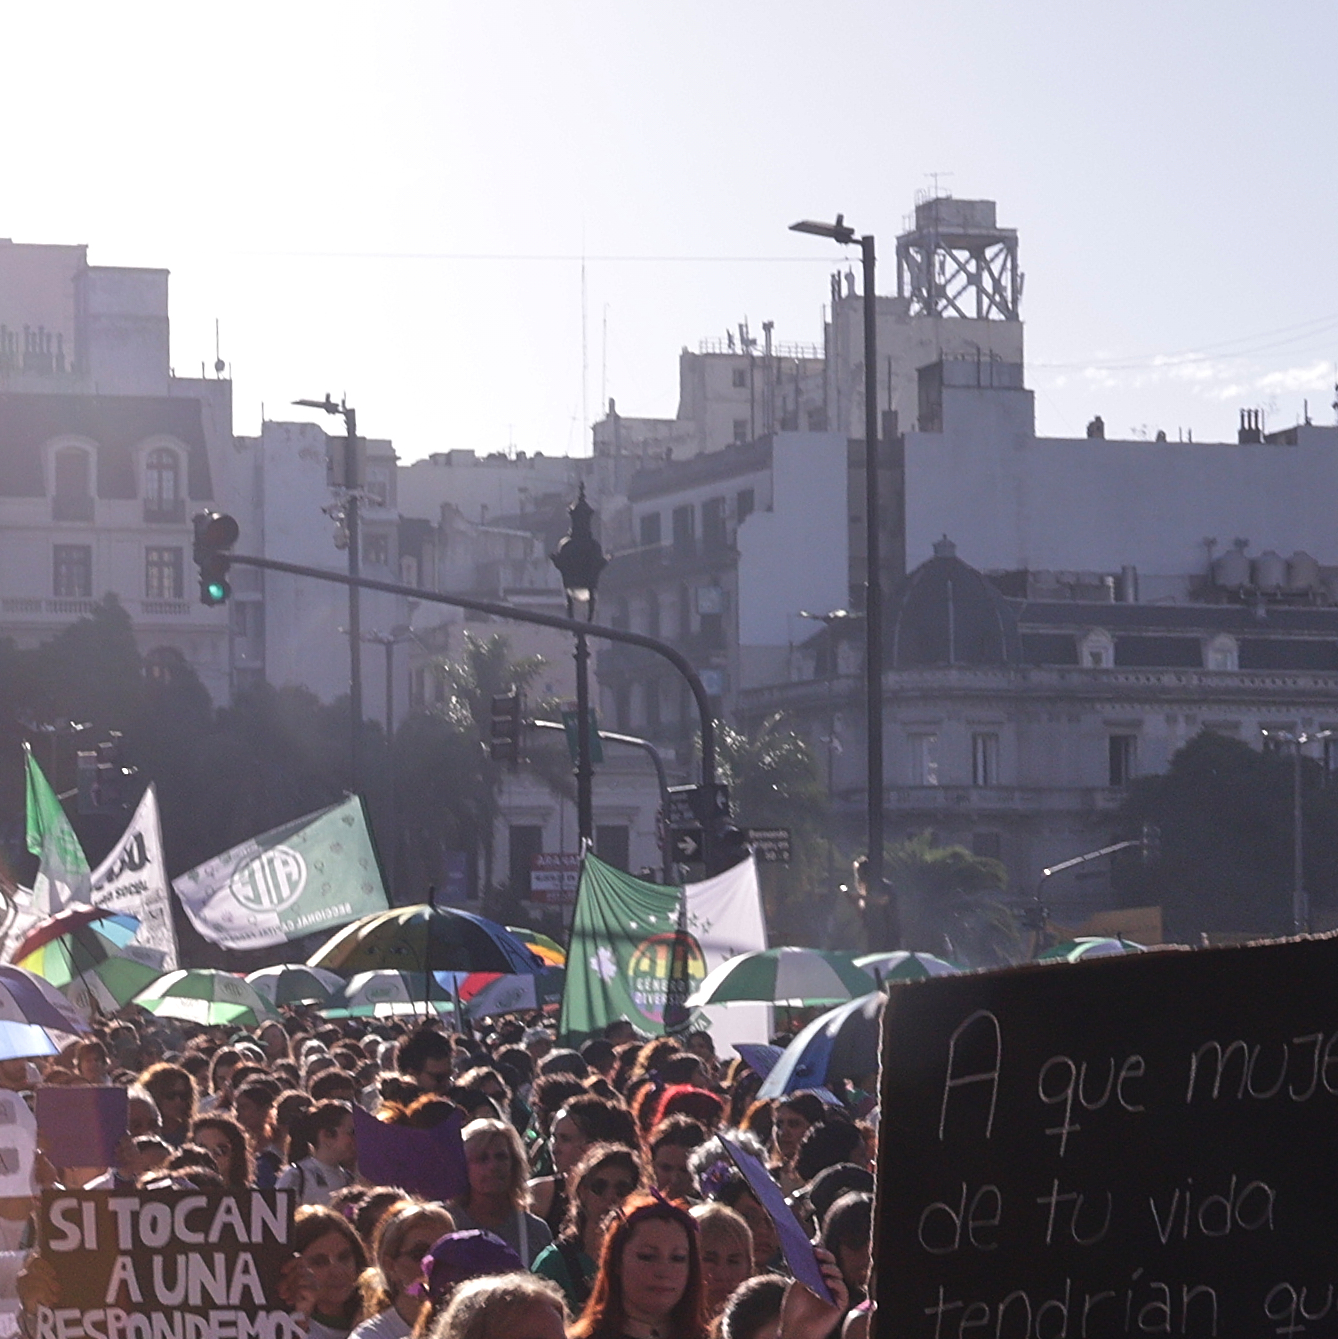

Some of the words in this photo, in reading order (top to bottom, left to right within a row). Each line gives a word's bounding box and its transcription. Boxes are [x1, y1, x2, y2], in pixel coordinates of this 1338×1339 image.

[938, 1009, 1002, 1140] A
[1038, 1054, 1147, 1157] que
[48, 1197, 99, 1252] SI
[109, 1191, 289, 1251] TOCAN
[918, 1182, 1002, 1253] de
[1037, 1178, 1112, 1246] tu
[1150, 1175, 1277, 1245] vida
[105, 1258, 142, 1305] A
[152, 1251, 267, 1307] UNA
